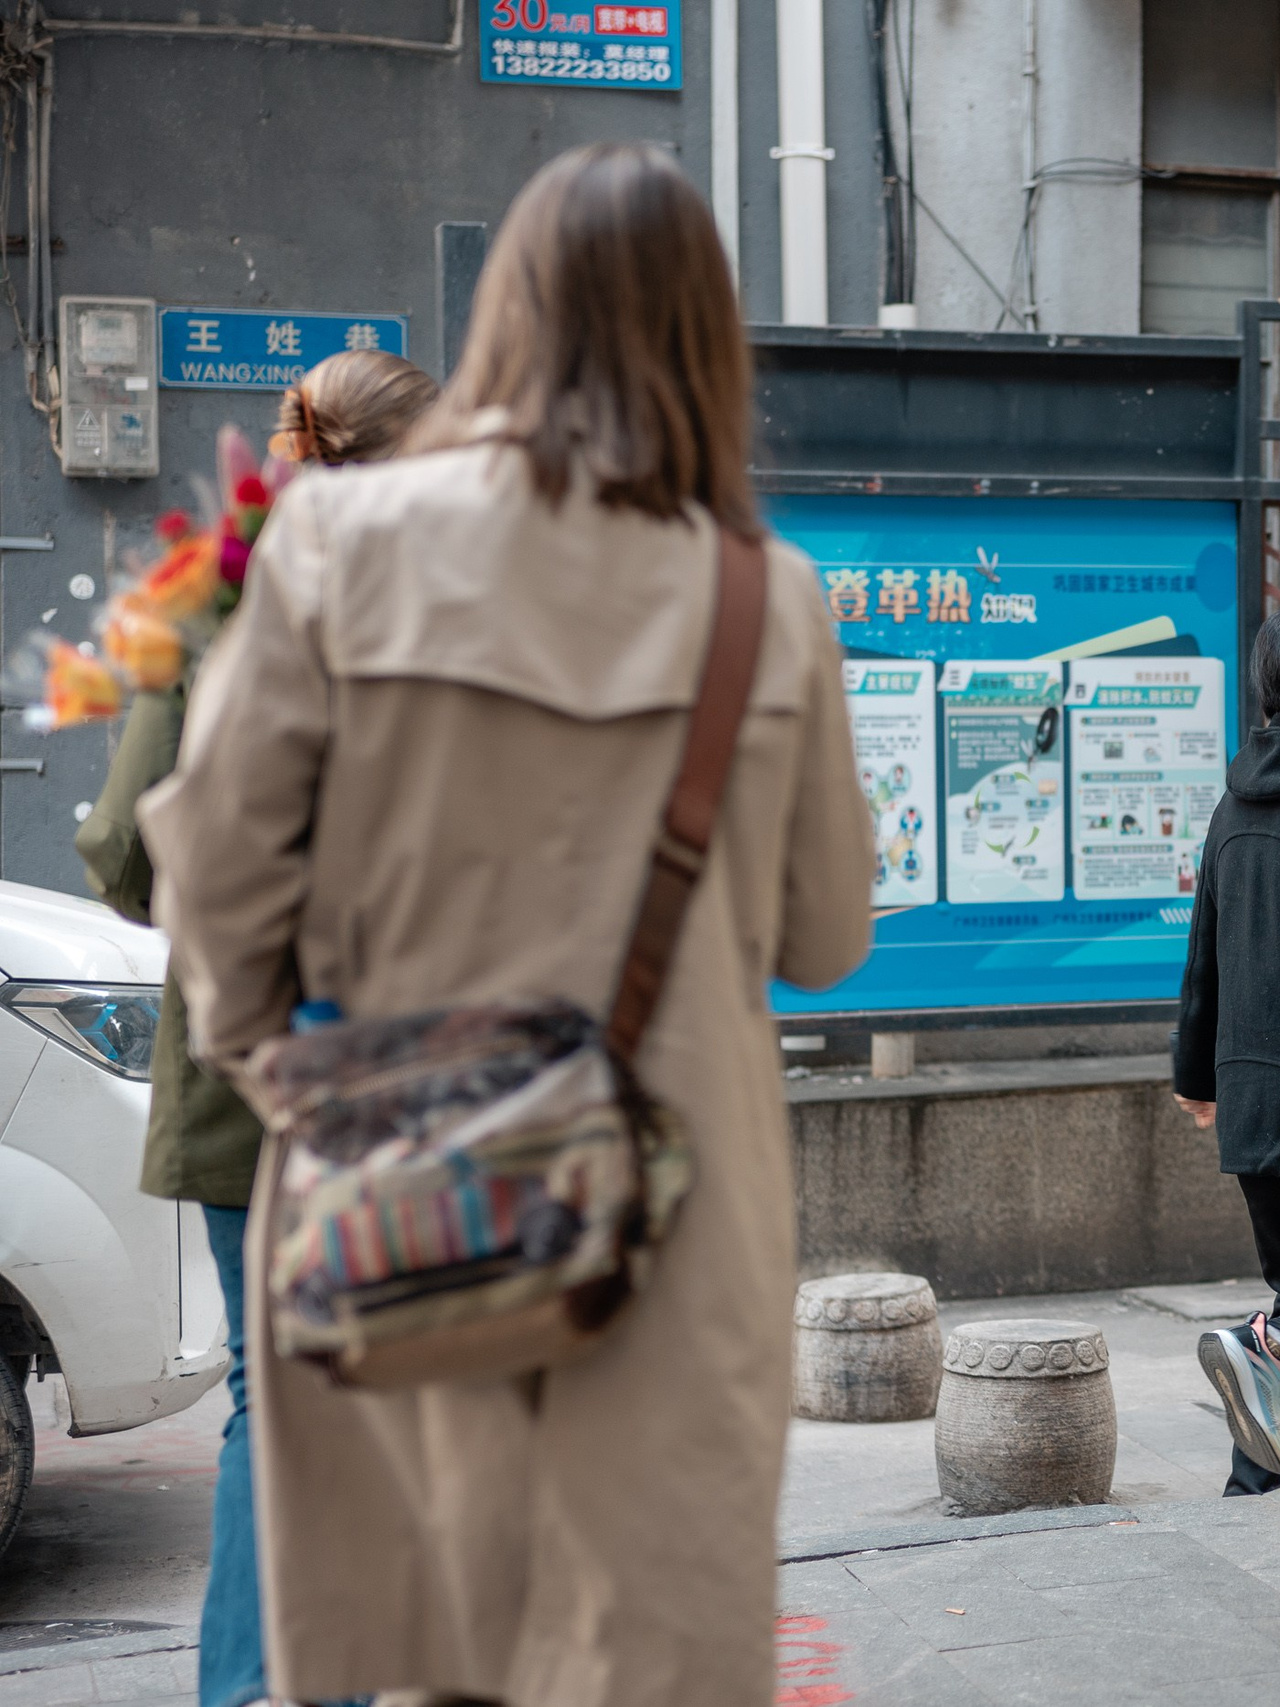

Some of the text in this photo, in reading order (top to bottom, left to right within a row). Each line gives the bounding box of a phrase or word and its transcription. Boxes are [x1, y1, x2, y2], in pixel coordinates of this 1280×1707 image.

[491, 56, 672, 81] 13822233850
[826, 568, 971, 624] 登革热
